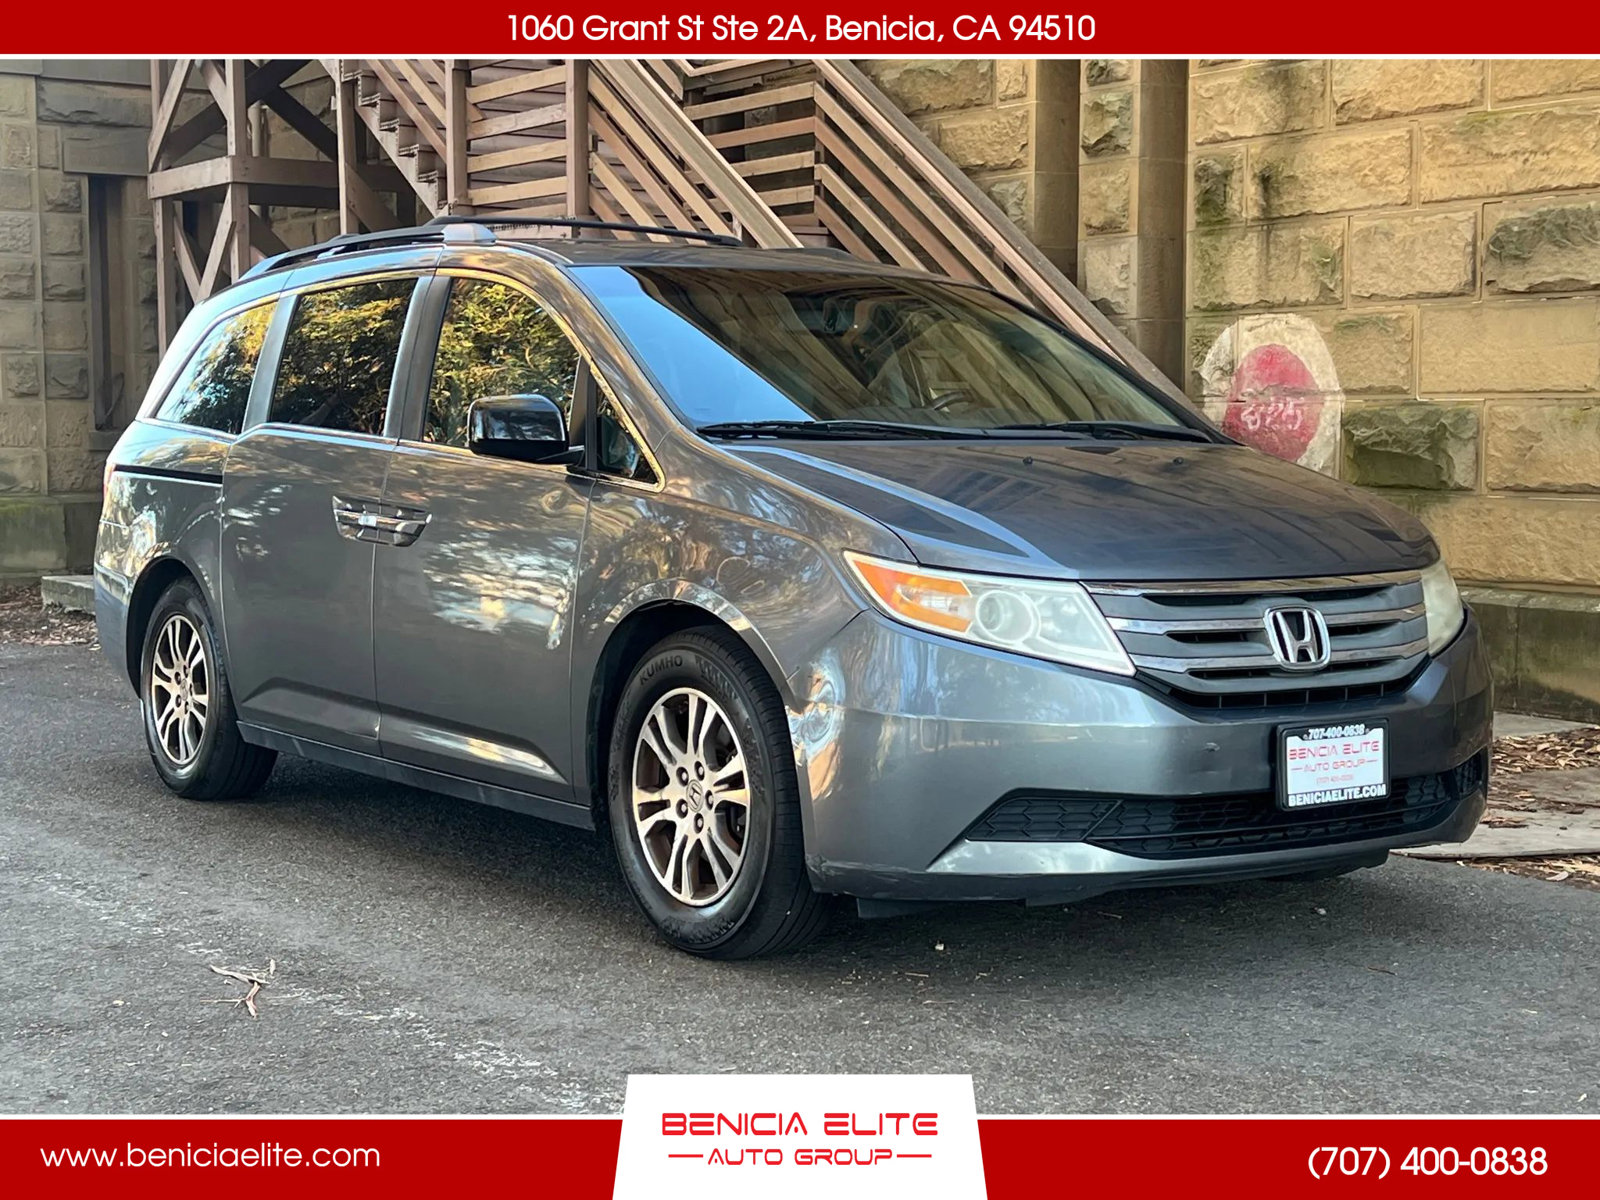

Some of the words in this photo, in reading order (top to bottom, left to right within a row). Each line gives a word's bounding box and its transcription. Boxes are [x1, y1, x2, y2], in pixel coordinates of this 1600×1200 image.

[640, 655, 683, 685] KUMHO
[1289, 745, 1338, 760] BENICIA
[1343, 740, 1380, 755] ELITE
[1304, 762, 1329, 772] AUTO
[1332, 758, 1366, 770] GROUP
[1288, 784, 1387, 807] BENICIAELITE.COM
